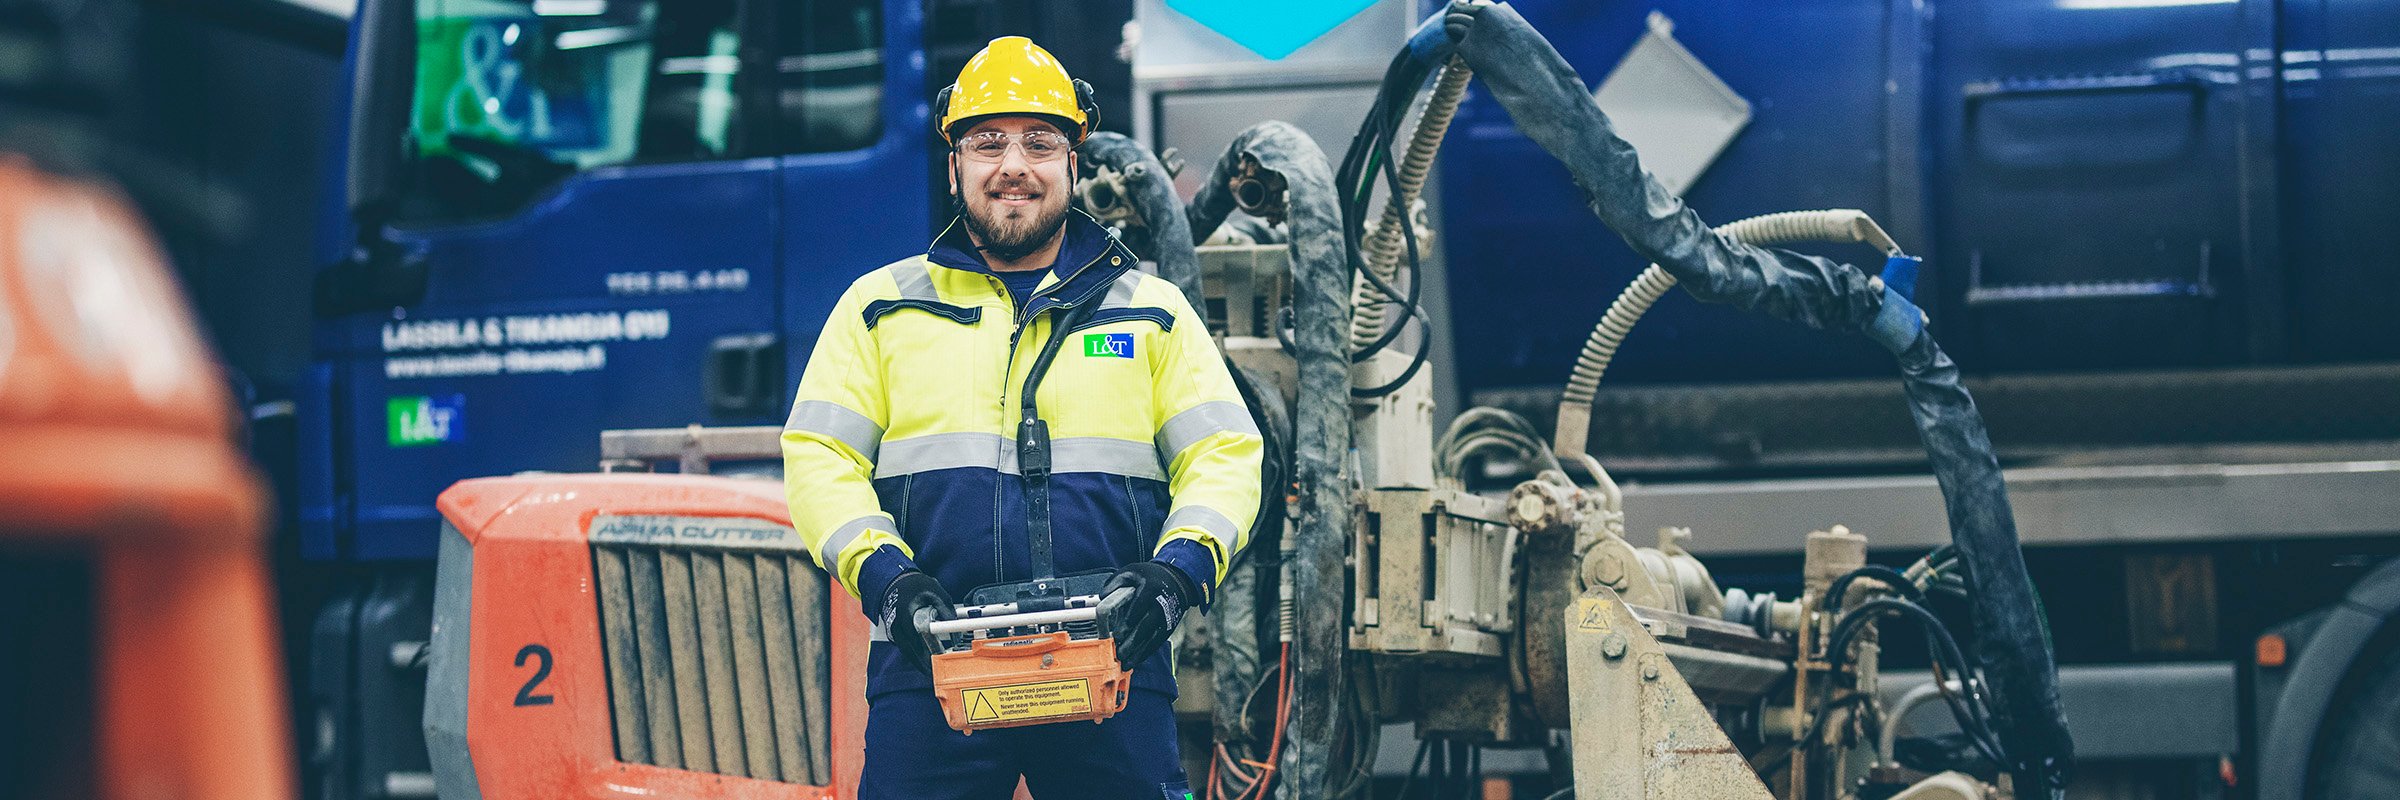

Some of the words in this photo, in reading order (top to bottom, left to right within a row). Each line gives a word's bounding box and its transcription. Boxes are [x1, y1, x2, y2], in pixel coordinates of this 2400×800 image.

[382, 319, 480, 351] LASSILA
[1092, 334, 1128, 355] L&T
[682, 526, 785, 540] CUTTER
[513, 644, 554, 706] 2
